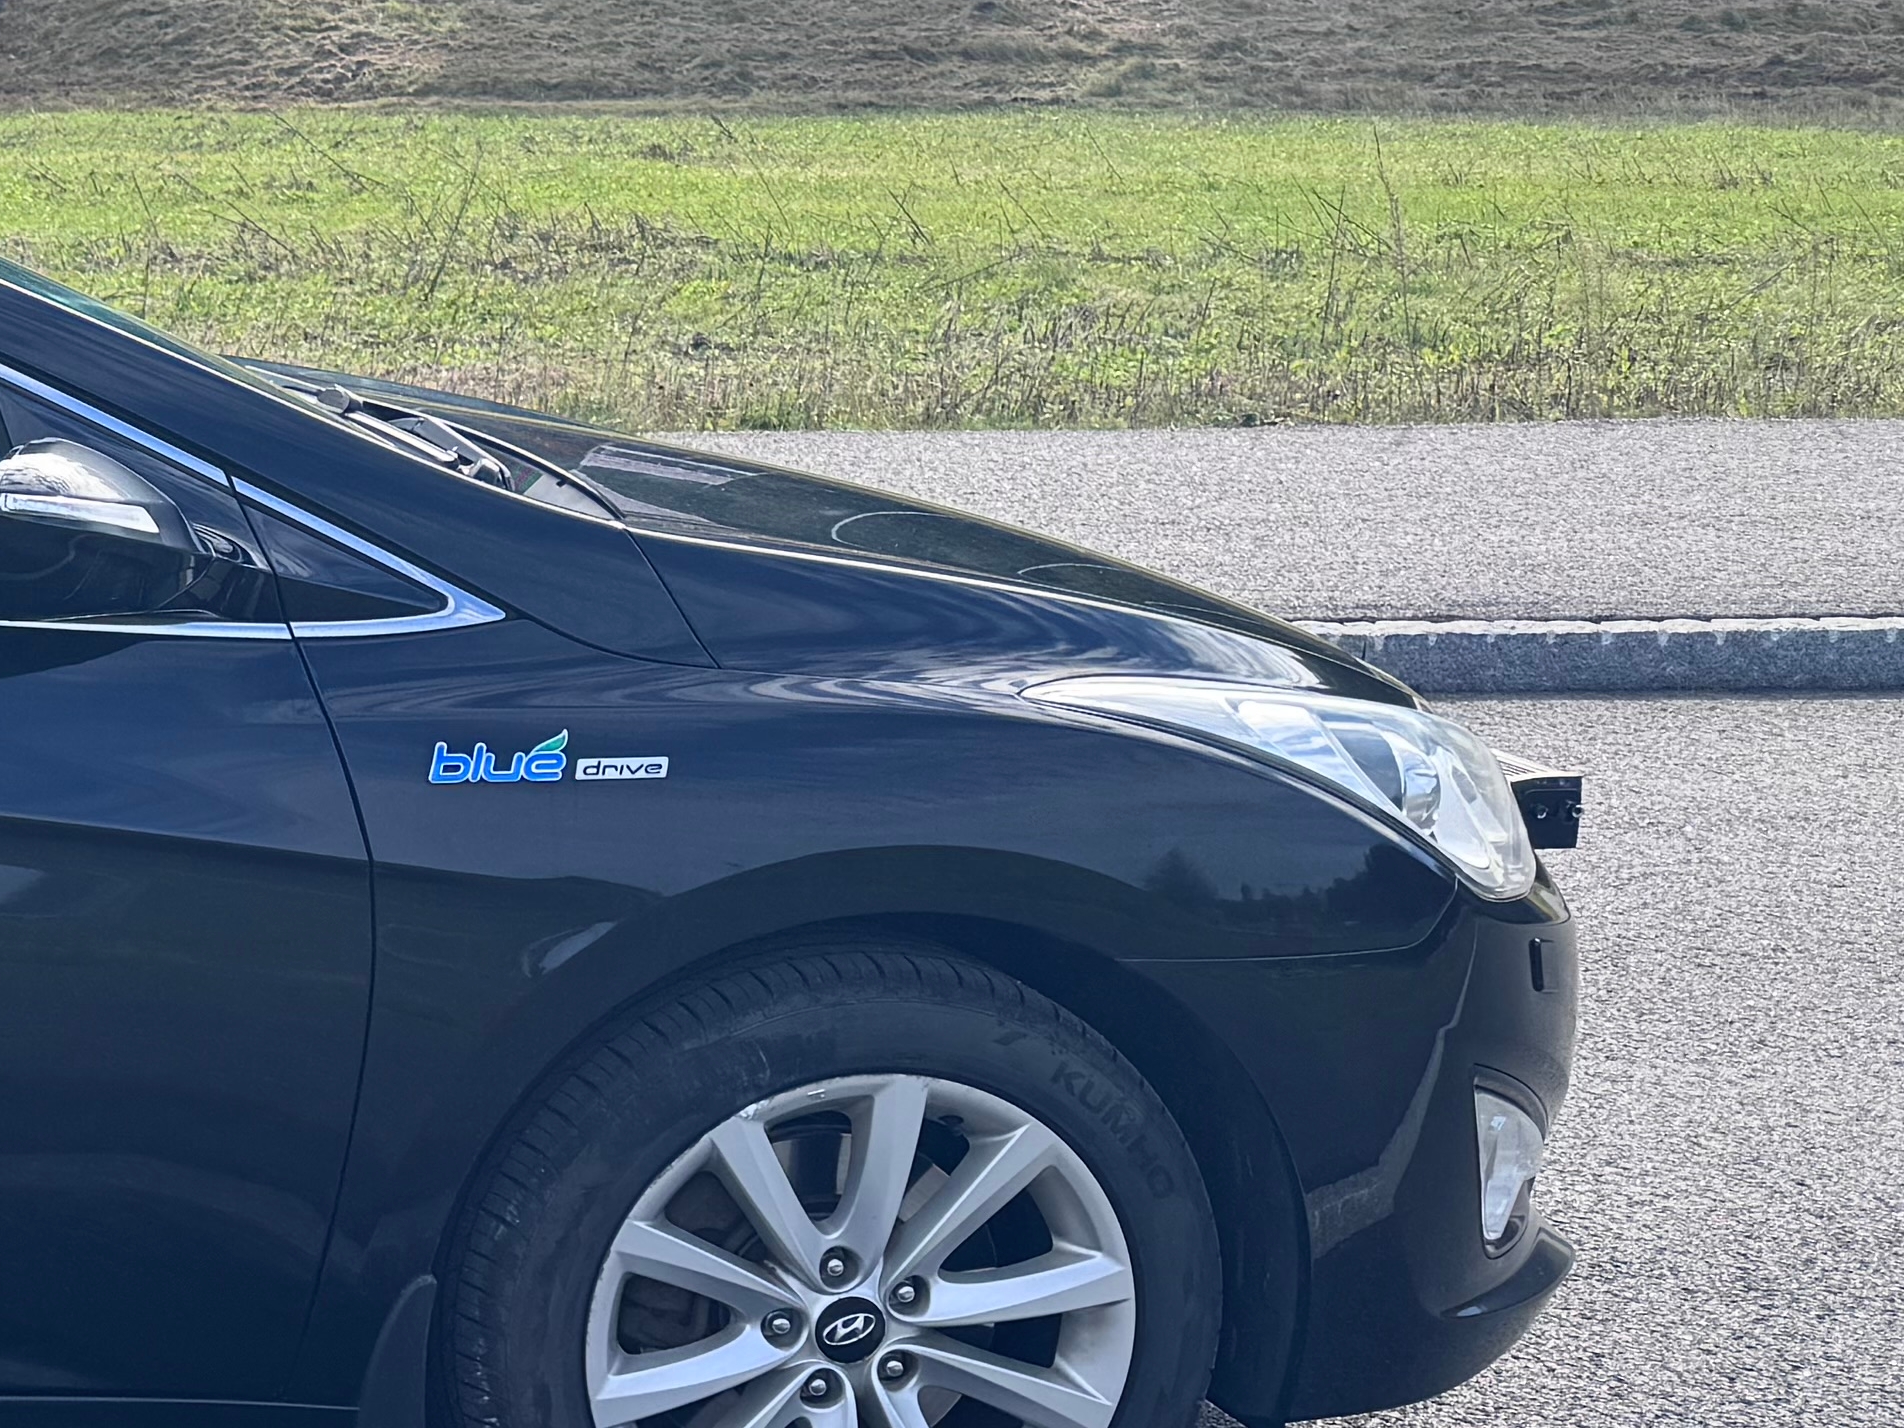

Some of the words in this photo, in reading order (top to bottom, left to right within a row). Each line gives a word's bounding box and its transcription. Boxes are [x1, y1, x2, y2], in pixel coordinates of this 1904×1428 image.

[429, 736, 567, 784] blue
[582, 760, 664, 777] drive
[1049, 1060, 1176, 1200] KUMHO
